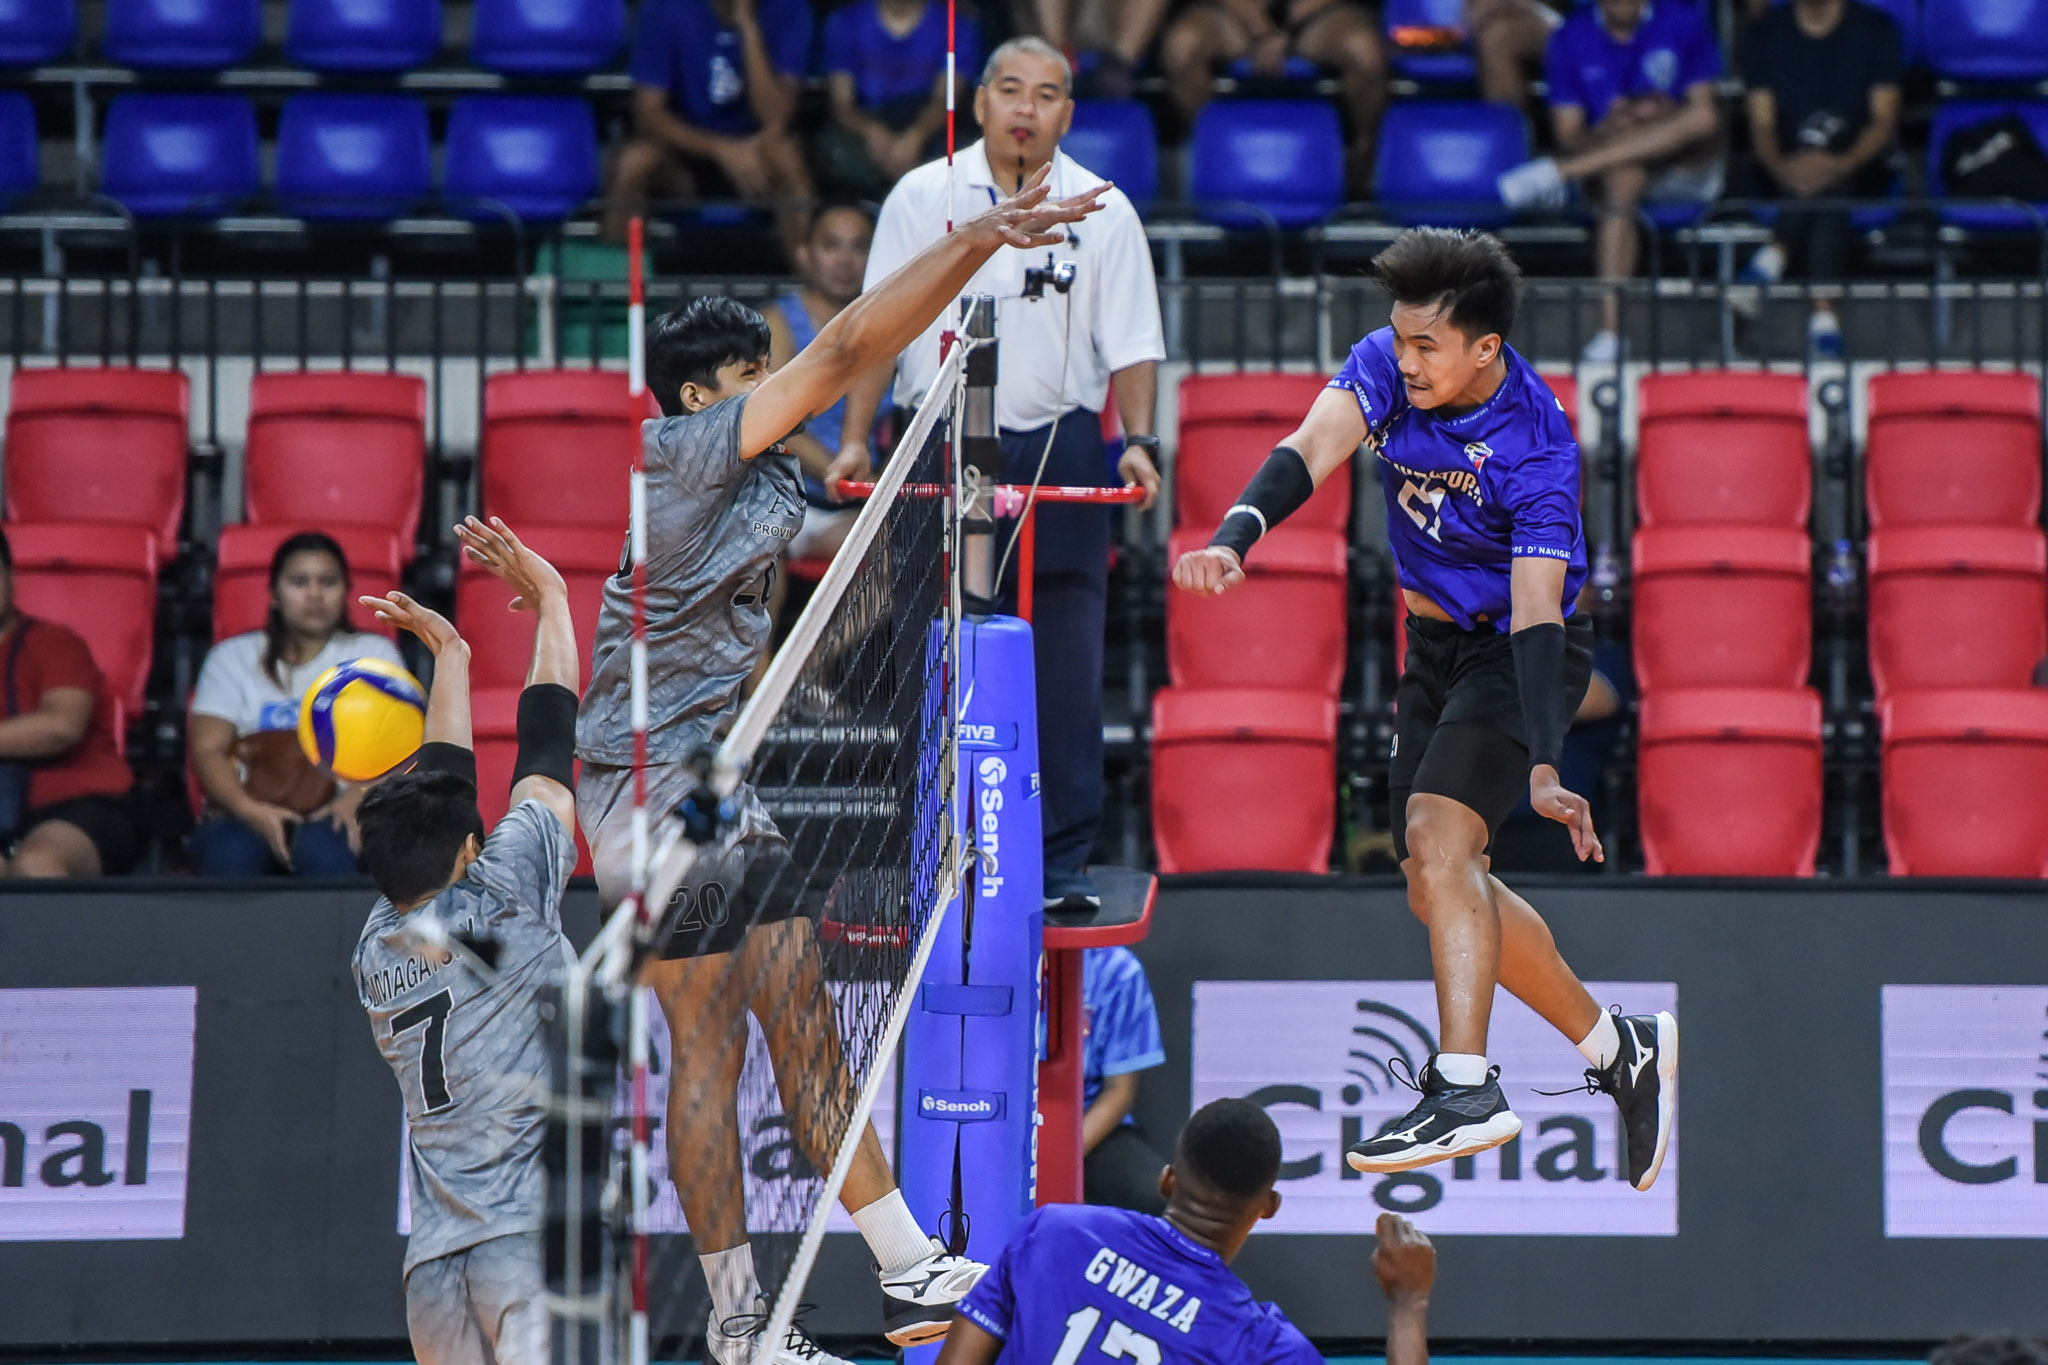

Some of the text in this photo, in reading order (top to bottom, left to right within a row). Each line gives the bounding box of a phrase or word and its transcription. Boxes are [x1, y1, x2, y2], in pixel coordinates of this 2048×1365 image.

[667, 880, 730, 934] 20
[389, 986, 456, 1113] 7
[935, 1099, 991, 1113] Senoh
[1084, 1246, 1203, 1335] GWAZA
